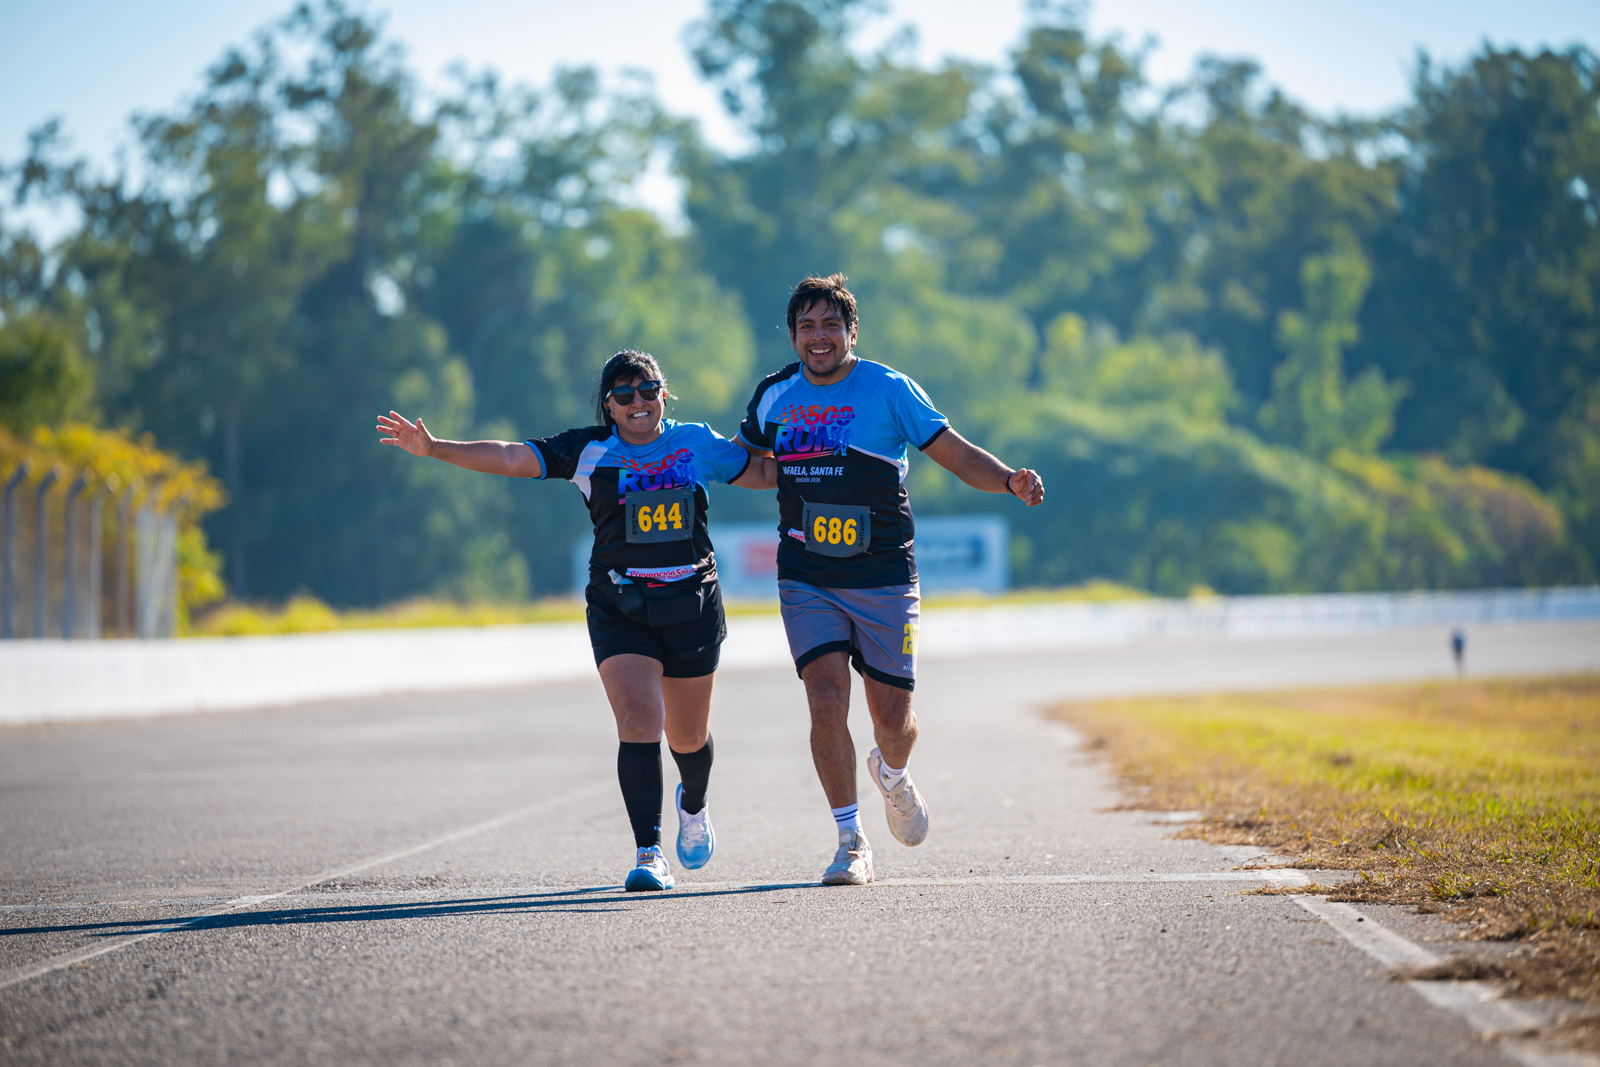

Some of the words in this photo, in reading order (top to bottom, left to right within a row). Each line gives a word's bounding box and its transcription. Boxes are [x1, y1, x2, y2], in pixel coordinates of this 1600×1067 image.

[774, 425, 838, 453] RUN
[618, 468, 684, 495] RUN
[810, 466, 833, 476] SANTA
[834, 466, 844, 476] FE
[638, 502, 683, 533] 644
[813, 516, 857, 546] 686
